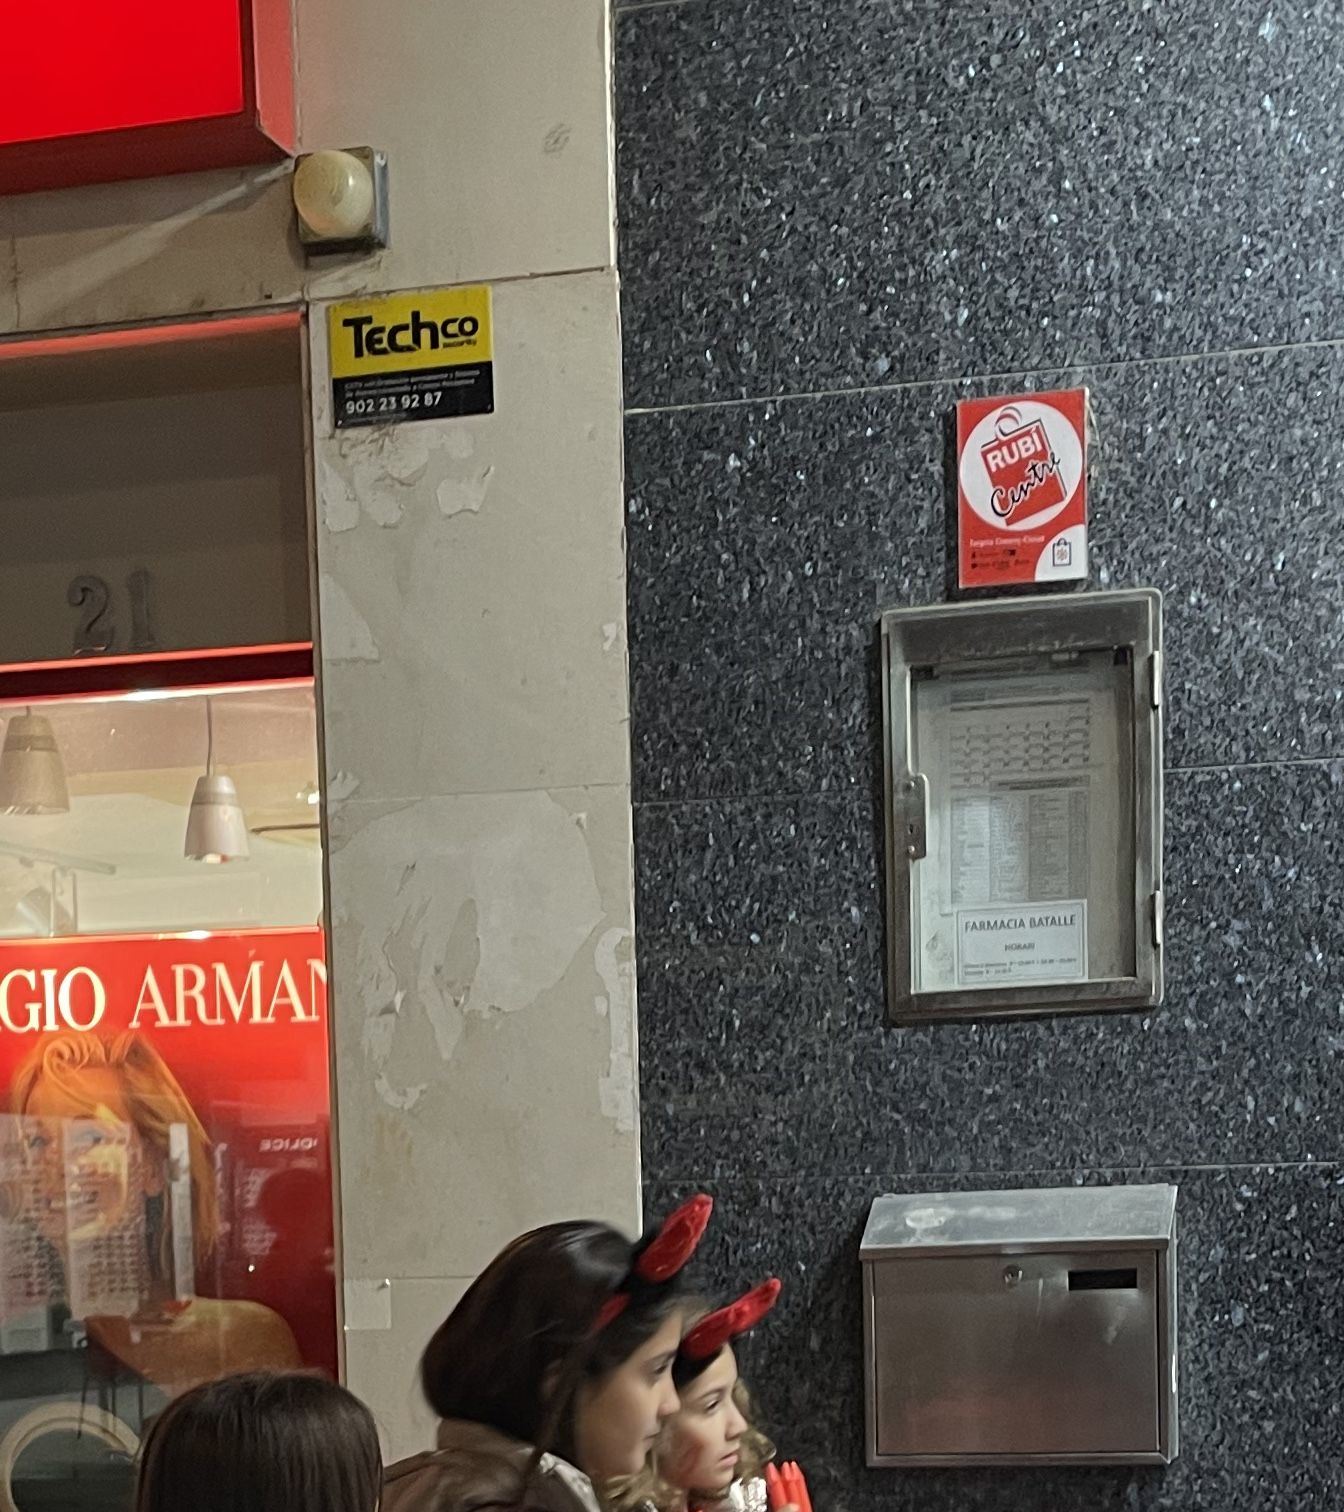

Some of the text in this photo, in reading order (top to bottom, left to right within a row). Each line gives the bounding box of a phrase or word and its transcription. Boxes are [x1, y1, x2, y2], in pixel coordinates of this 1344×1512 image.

[345, 391, 443, 414] 902 23 92 87
[986, 426, 1043, 473] RUBÍ
[990, 451, 1061, 517] Centre
[67, 568, 158, 655] 21
[965, 918, 1026, 933] FARMACIA
